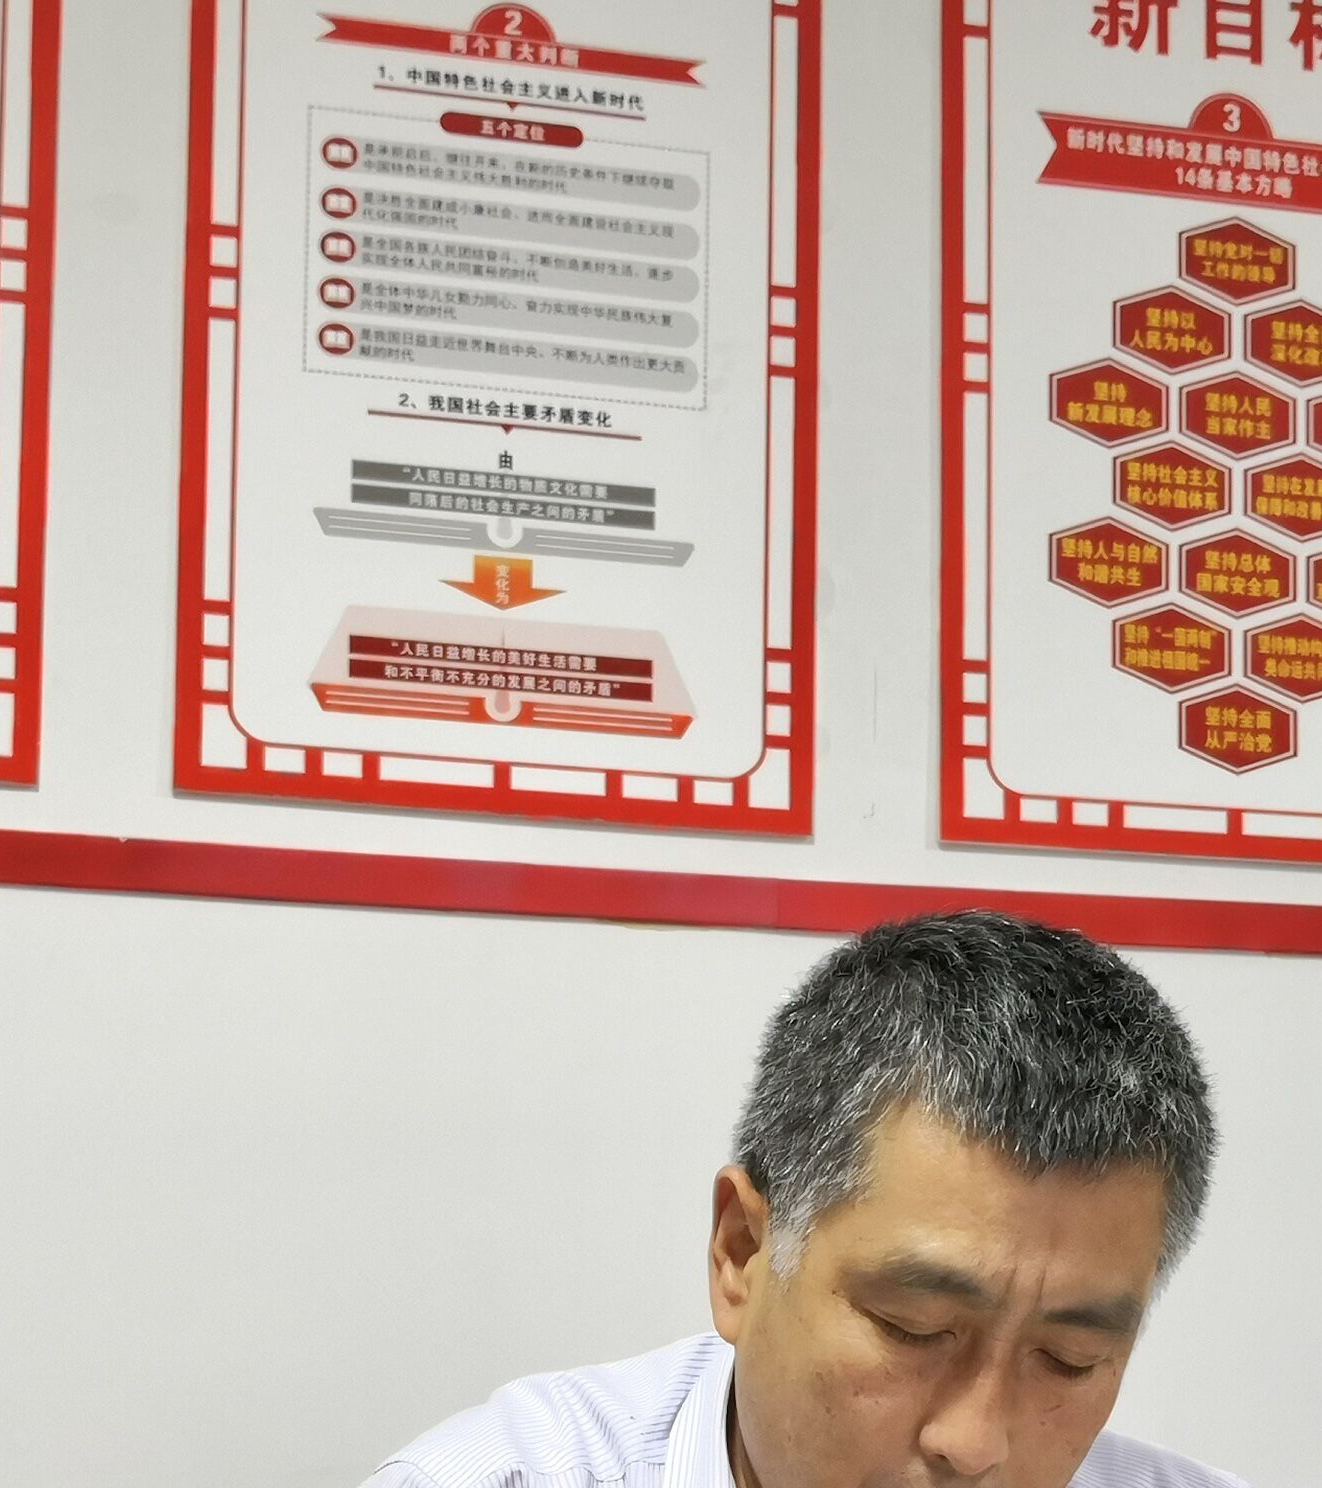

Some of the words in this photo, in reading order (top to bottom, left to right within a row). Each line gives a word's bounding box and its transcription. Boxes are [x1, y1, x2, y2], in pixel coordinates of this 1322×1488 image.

[504, 10, 523, 36] 2
[449, 35, 579, 68] 两个重大判断
[480, 119, 545, 142] 五个定位
[1222, 103, 1241, 132] 3
[1175, 166, 1293, 199] 14条基本方略
[1145, 306, 1196, 330] 坚持以
[1129, 329, 1213, 356] 人民为中心
[1093, 380, 1128, 402] 坚持
[398, 392, 613, 428] 2、我国社会主要矛盾变化
[1067, 401, 1154, 430] 新发展理念
[1204, 392, 1272, 419] 坚持人民
[1205, 415, 1272, 440] 当家作主
[498, 451, 514, 470] 由
[1127, 461, 1219, 489] 坚持社会主义
[1128, 484, 1219, 512] 核心价值体系
[1061, 537, 1159, 565] 坚持人与自然
[1204, 550, 1271, 574] 坚持总体
[494, 563, 510, 604] 变化为
[1077, 562, 1142, 588] 和谐共生
[1196, 573, 1280, 600] 国家安全观
[1204, 705, 1271, 730] 坚持全面
[1204, 729, 1272, 754] 从严治党
